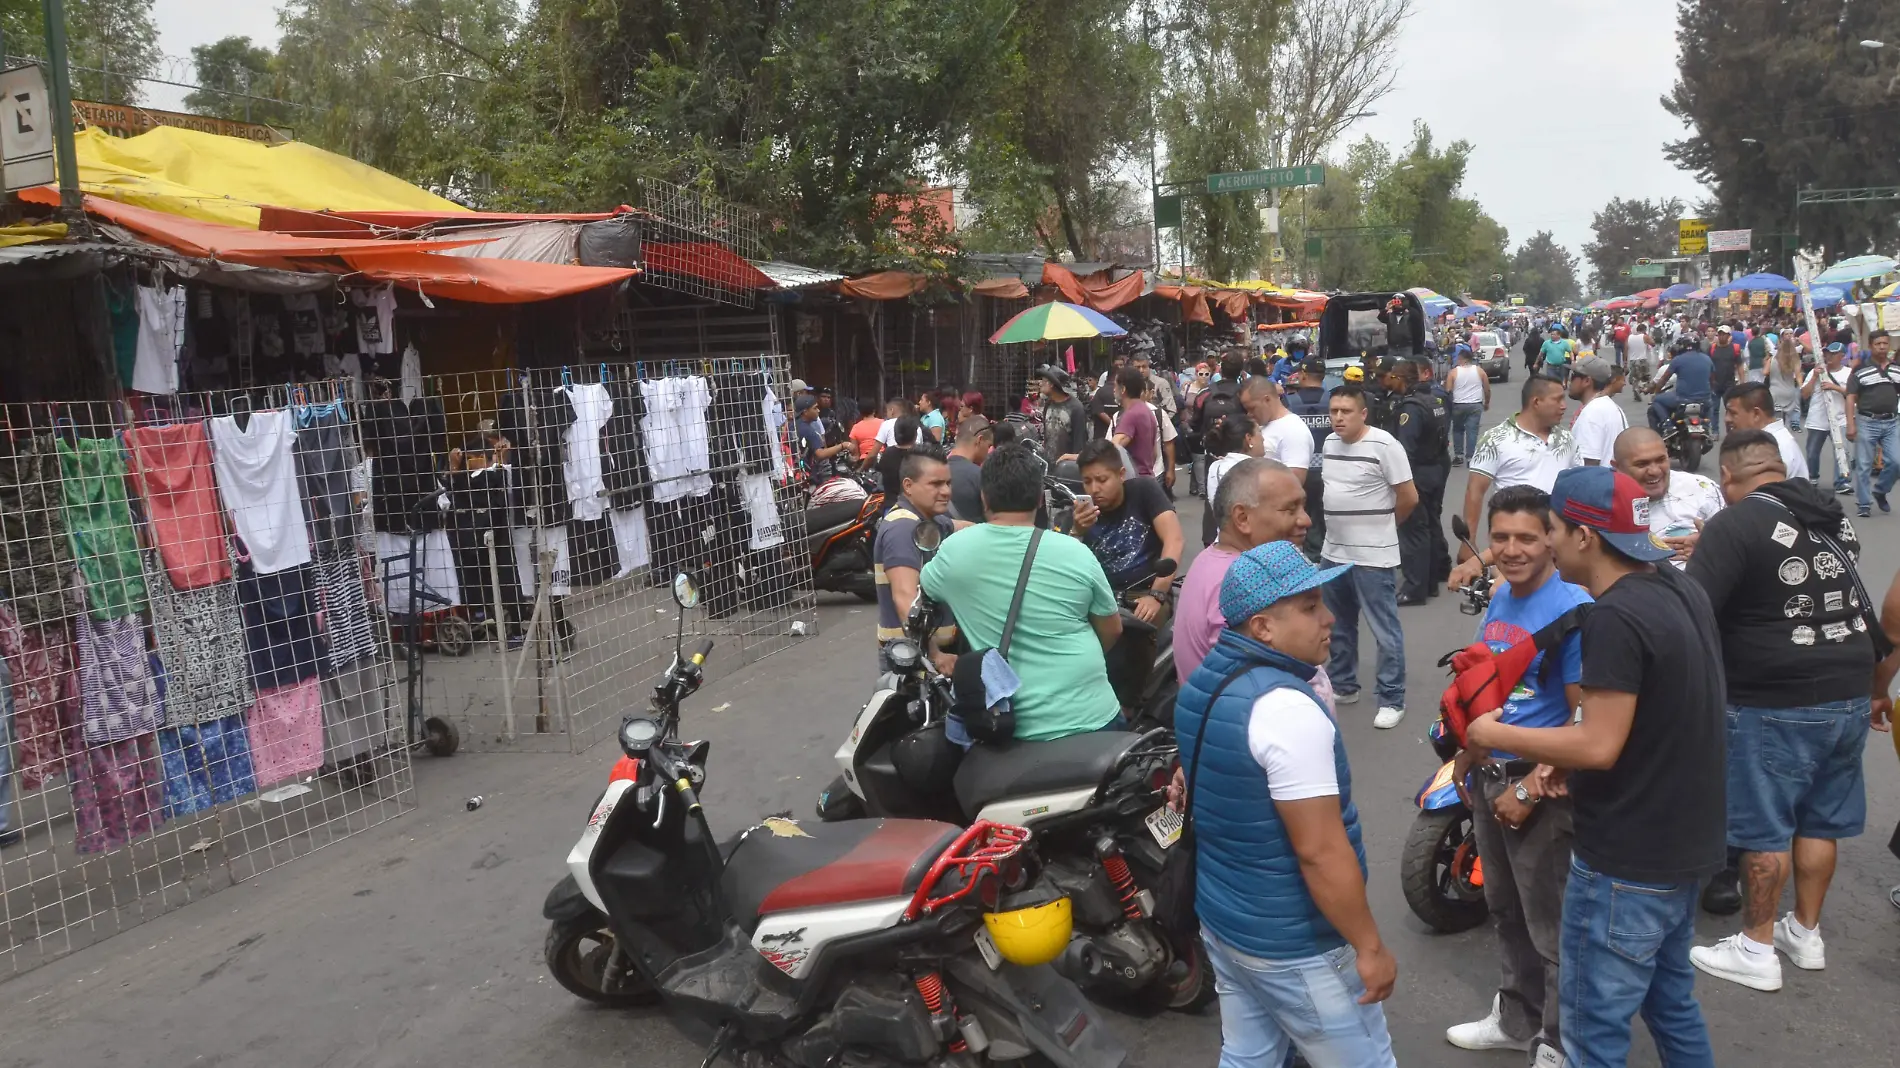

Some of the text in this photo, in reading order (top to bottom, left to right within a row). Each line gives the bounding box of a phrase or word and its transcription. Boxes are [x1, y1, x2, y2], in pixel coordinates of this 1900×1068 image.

[72, 104, 126, 122] RETARIA
[132, 113, 149, 127] DE
[1218, 170, 1294, 189] AEROPUERTO
[1301, 415, 1332, 425] OLICÍA
[1815, 554, 1834, 567] NEW
[1817, 562, 1845, 578] YORK
